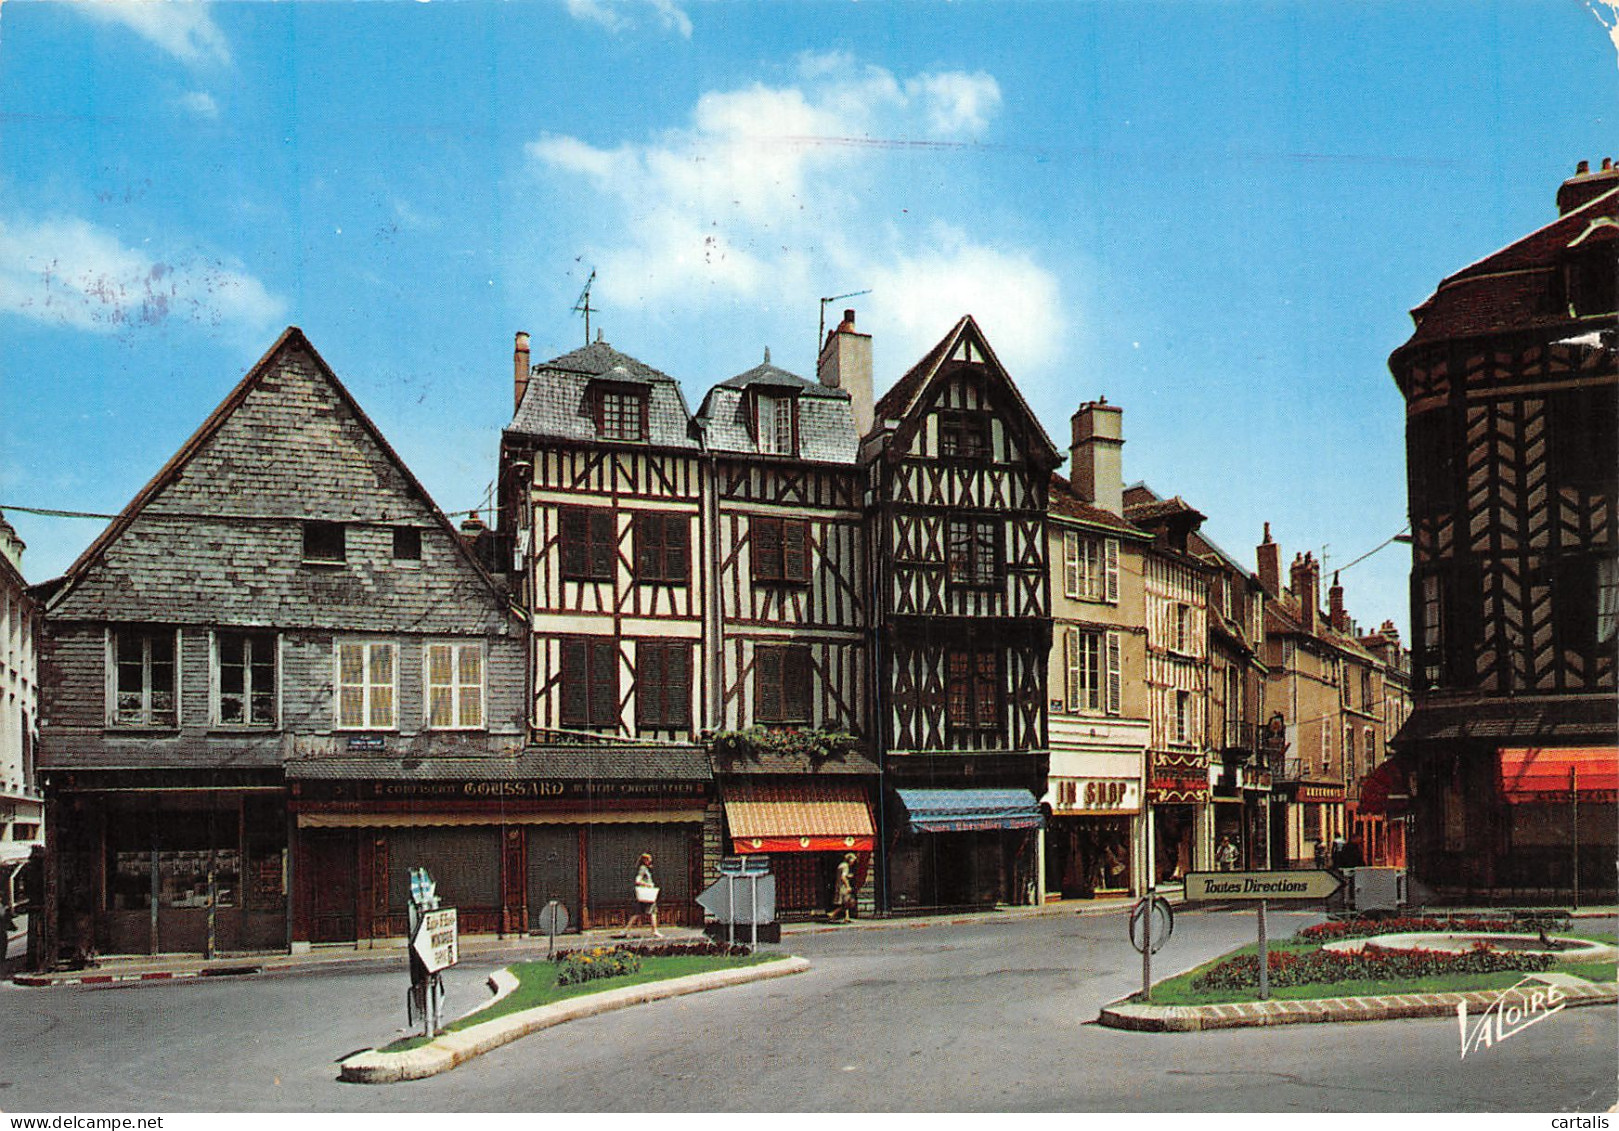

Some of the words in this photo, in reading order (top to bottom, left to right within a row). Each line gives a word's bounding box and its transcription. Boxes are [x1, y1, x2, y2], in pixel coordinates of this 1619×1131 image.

[464, 782, 564, 796] GOUSSARD
[1085, 782, 1126, 804] SHOP
[1204, 879, 1241, 894] Toutes
[1243, 878, 1308, 893] Directions
